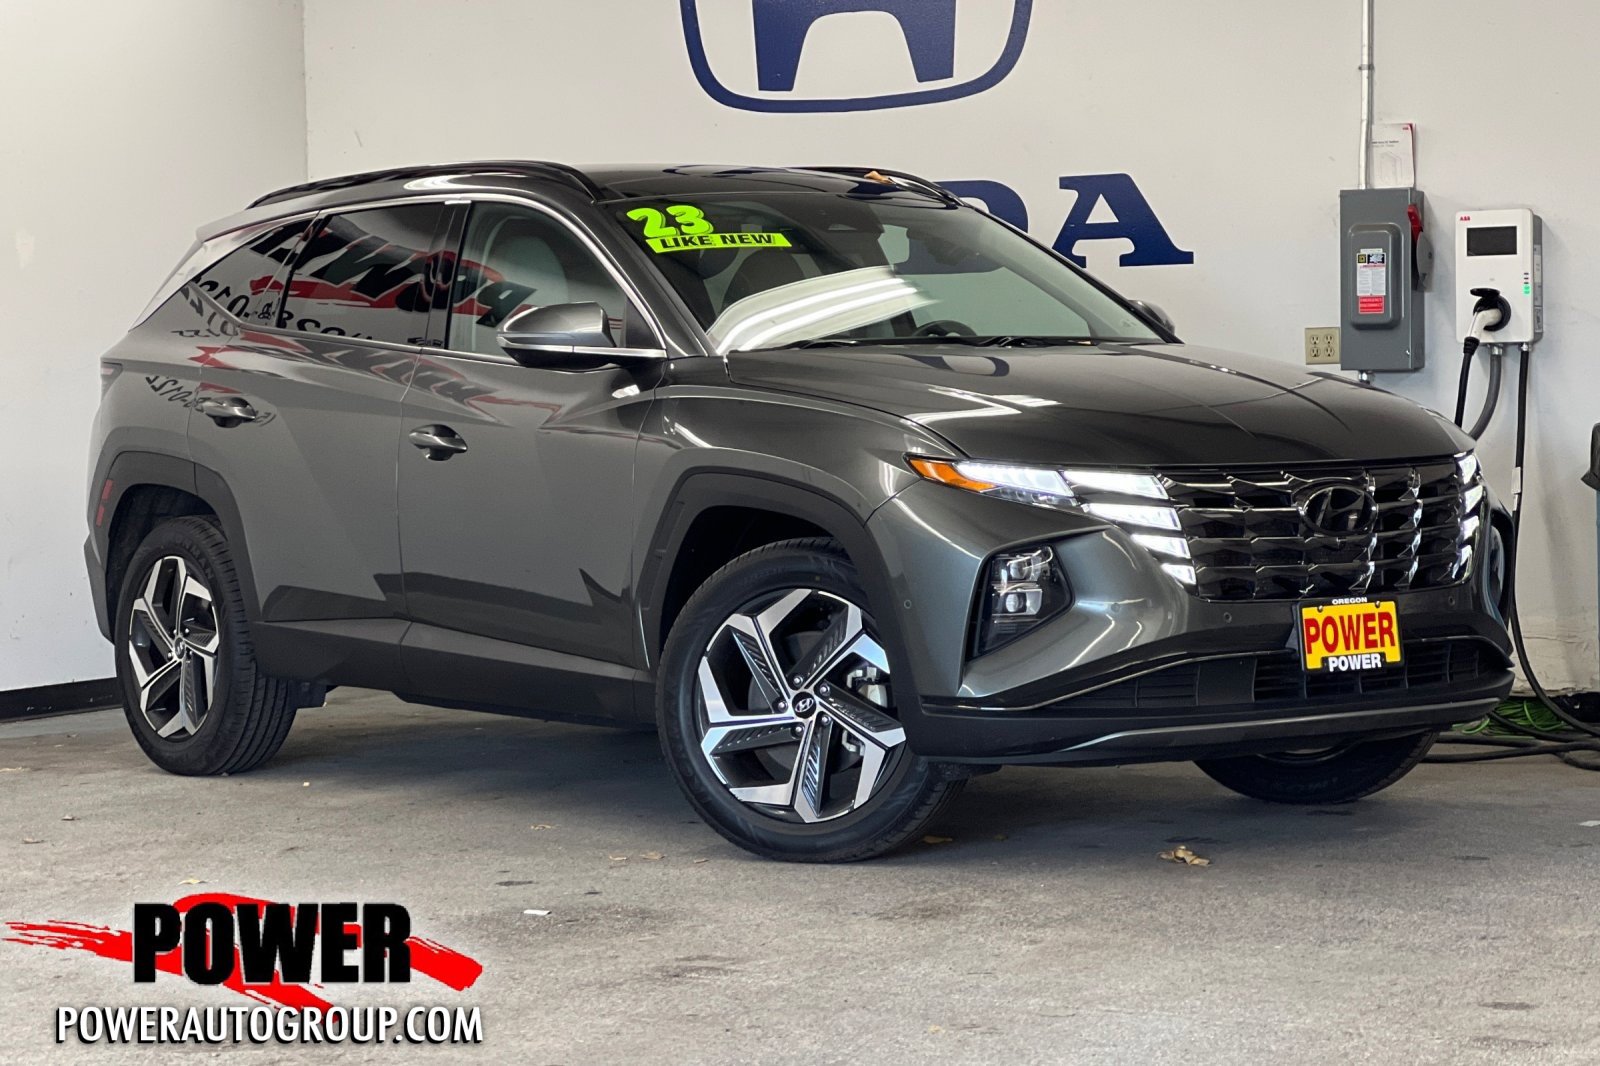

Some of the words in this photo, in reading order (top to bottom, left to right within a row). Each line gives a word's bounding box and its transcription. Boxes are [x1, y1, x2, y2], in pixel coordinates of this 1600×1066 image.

[626, 205, 714, 238] 23
[660, 233, 713, 249] LIKE
[721, 233, 774, 245] NEW
[1331, 597, 1368, 605] OREGON
[1304, 611, 1396, 654] POWER
[1328, 653, 1382, 672] POWER
